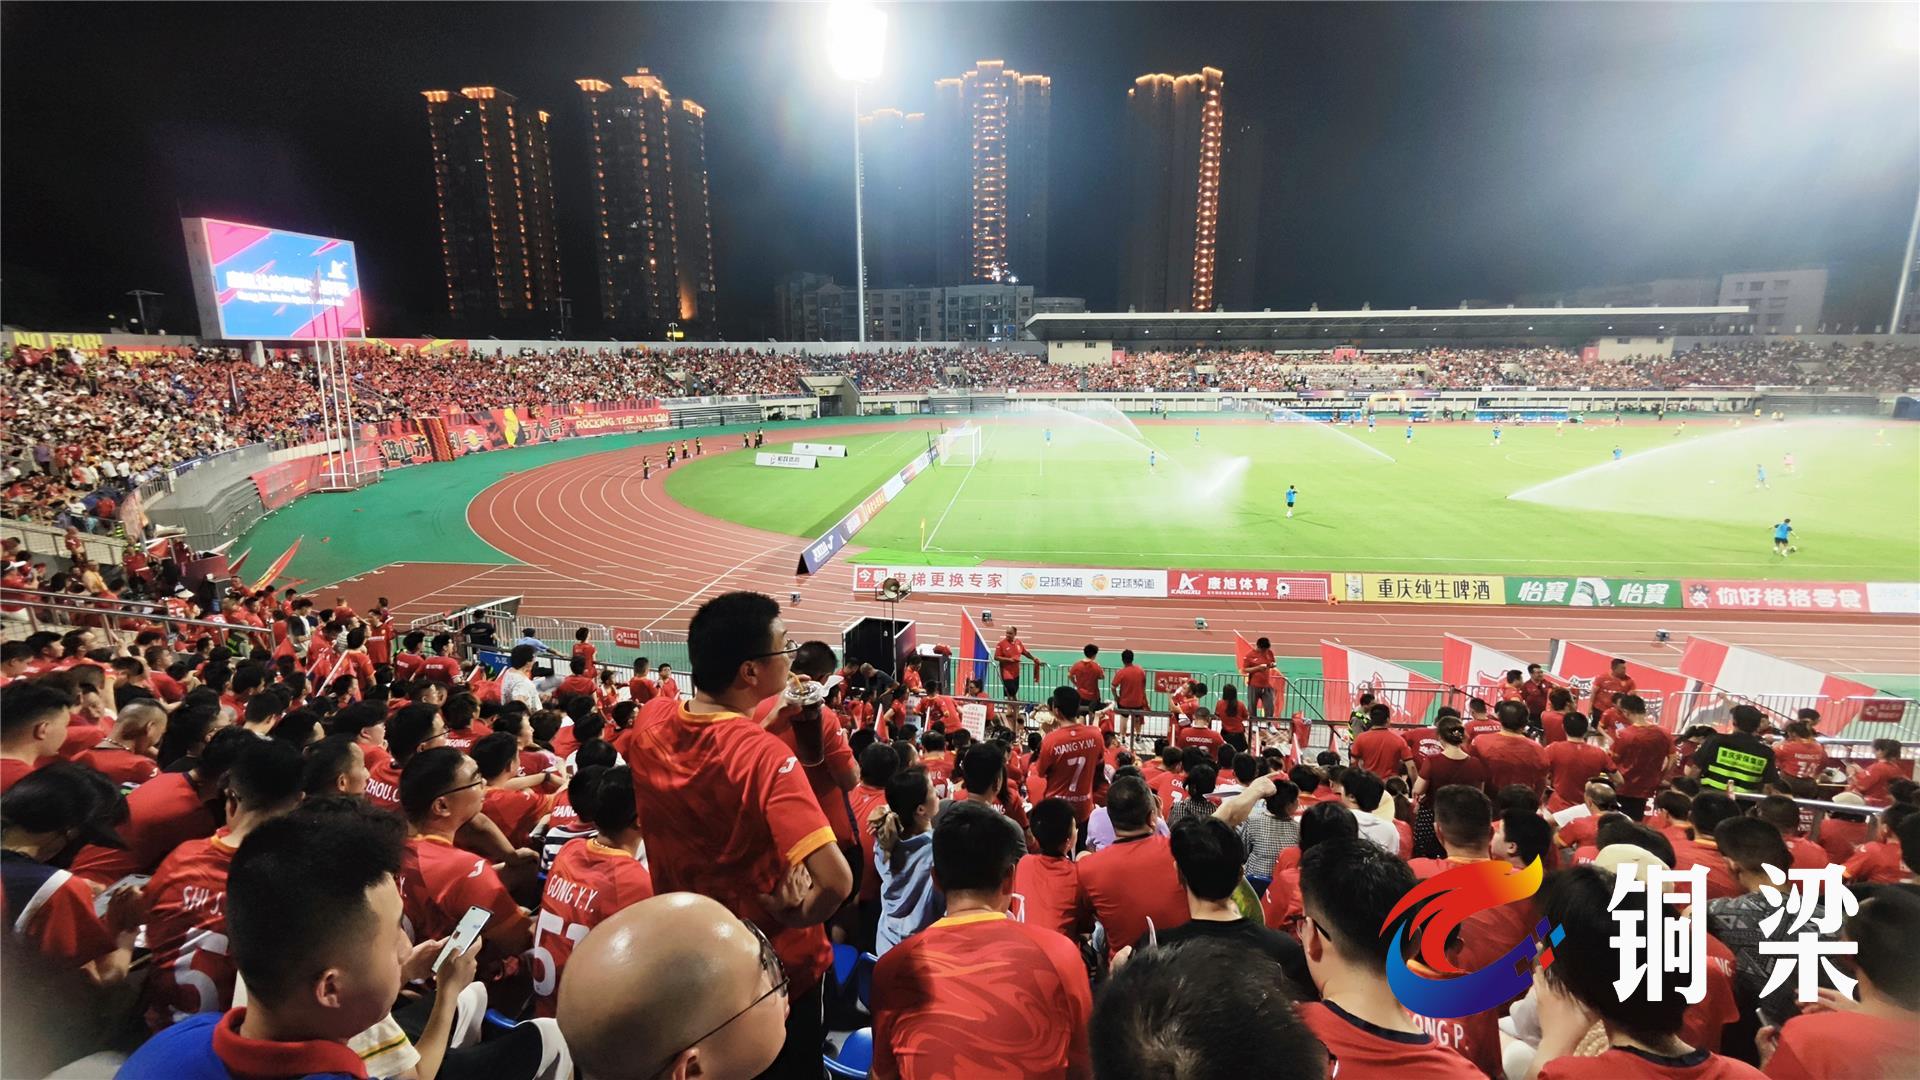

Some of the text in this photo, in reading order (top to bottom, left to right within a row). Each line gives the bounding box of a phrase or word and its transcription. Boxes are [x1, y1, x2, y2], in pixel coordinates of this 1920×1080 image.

[13, 332, 103, 349] NO FEAR!
[576, 417, 614, 430] ROCKING
[616, 416, 636, 425] THE
[636, 412, 669, 423] NATION
[1207, 577, 1269, 591] 康旭体育
[1377, 578, 1490, 600] 重庆纯生啤酒
[1517, 581, 1569, 603] 怡寶
[1618, 583, 1670, 605] 怡寶
[1716, 586, 1861, 609] 你好格格零食
[1054, 742, 1078, 756] XIANG
[1067, 756, 1086, 792] 7
[547, 874, 598, 913] GONG Y.Y.
